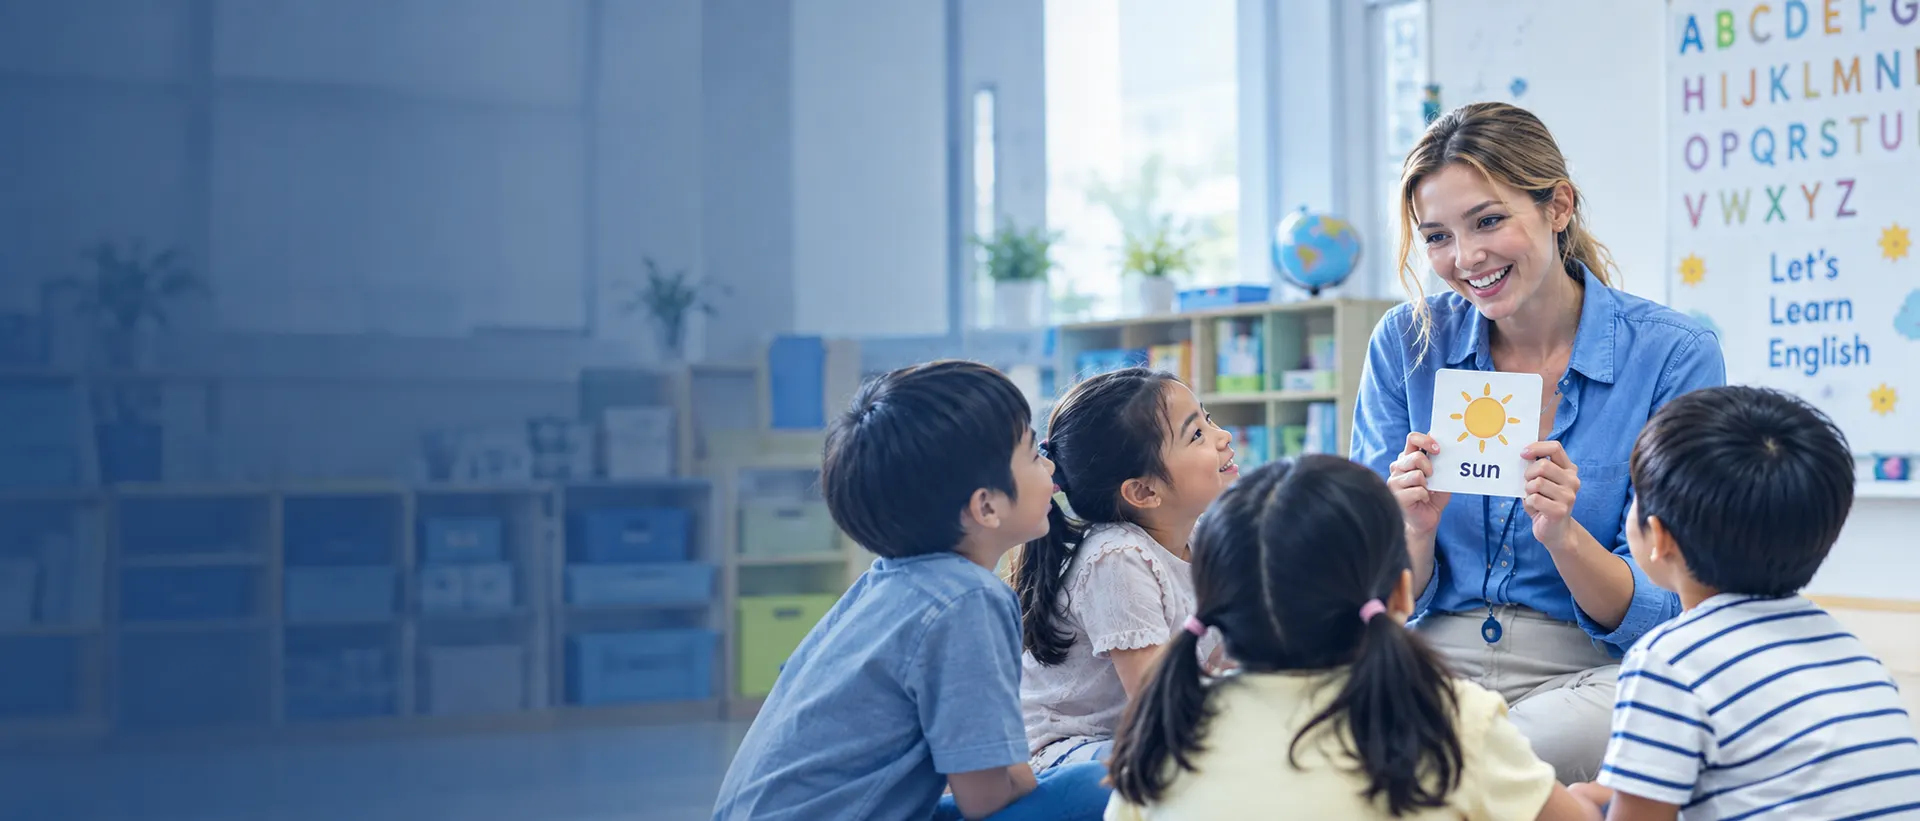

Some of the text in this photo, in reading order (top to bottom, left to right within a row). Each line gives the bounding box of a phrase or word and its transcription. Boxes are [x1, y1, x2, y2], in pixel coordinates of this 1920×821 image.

[1770, 249, 1839, 283] Let's
[1769, 297, 1853, 325] Learn
[1769, 334, 1870, 376] English
[1459, 461, 1500, 479] sun
